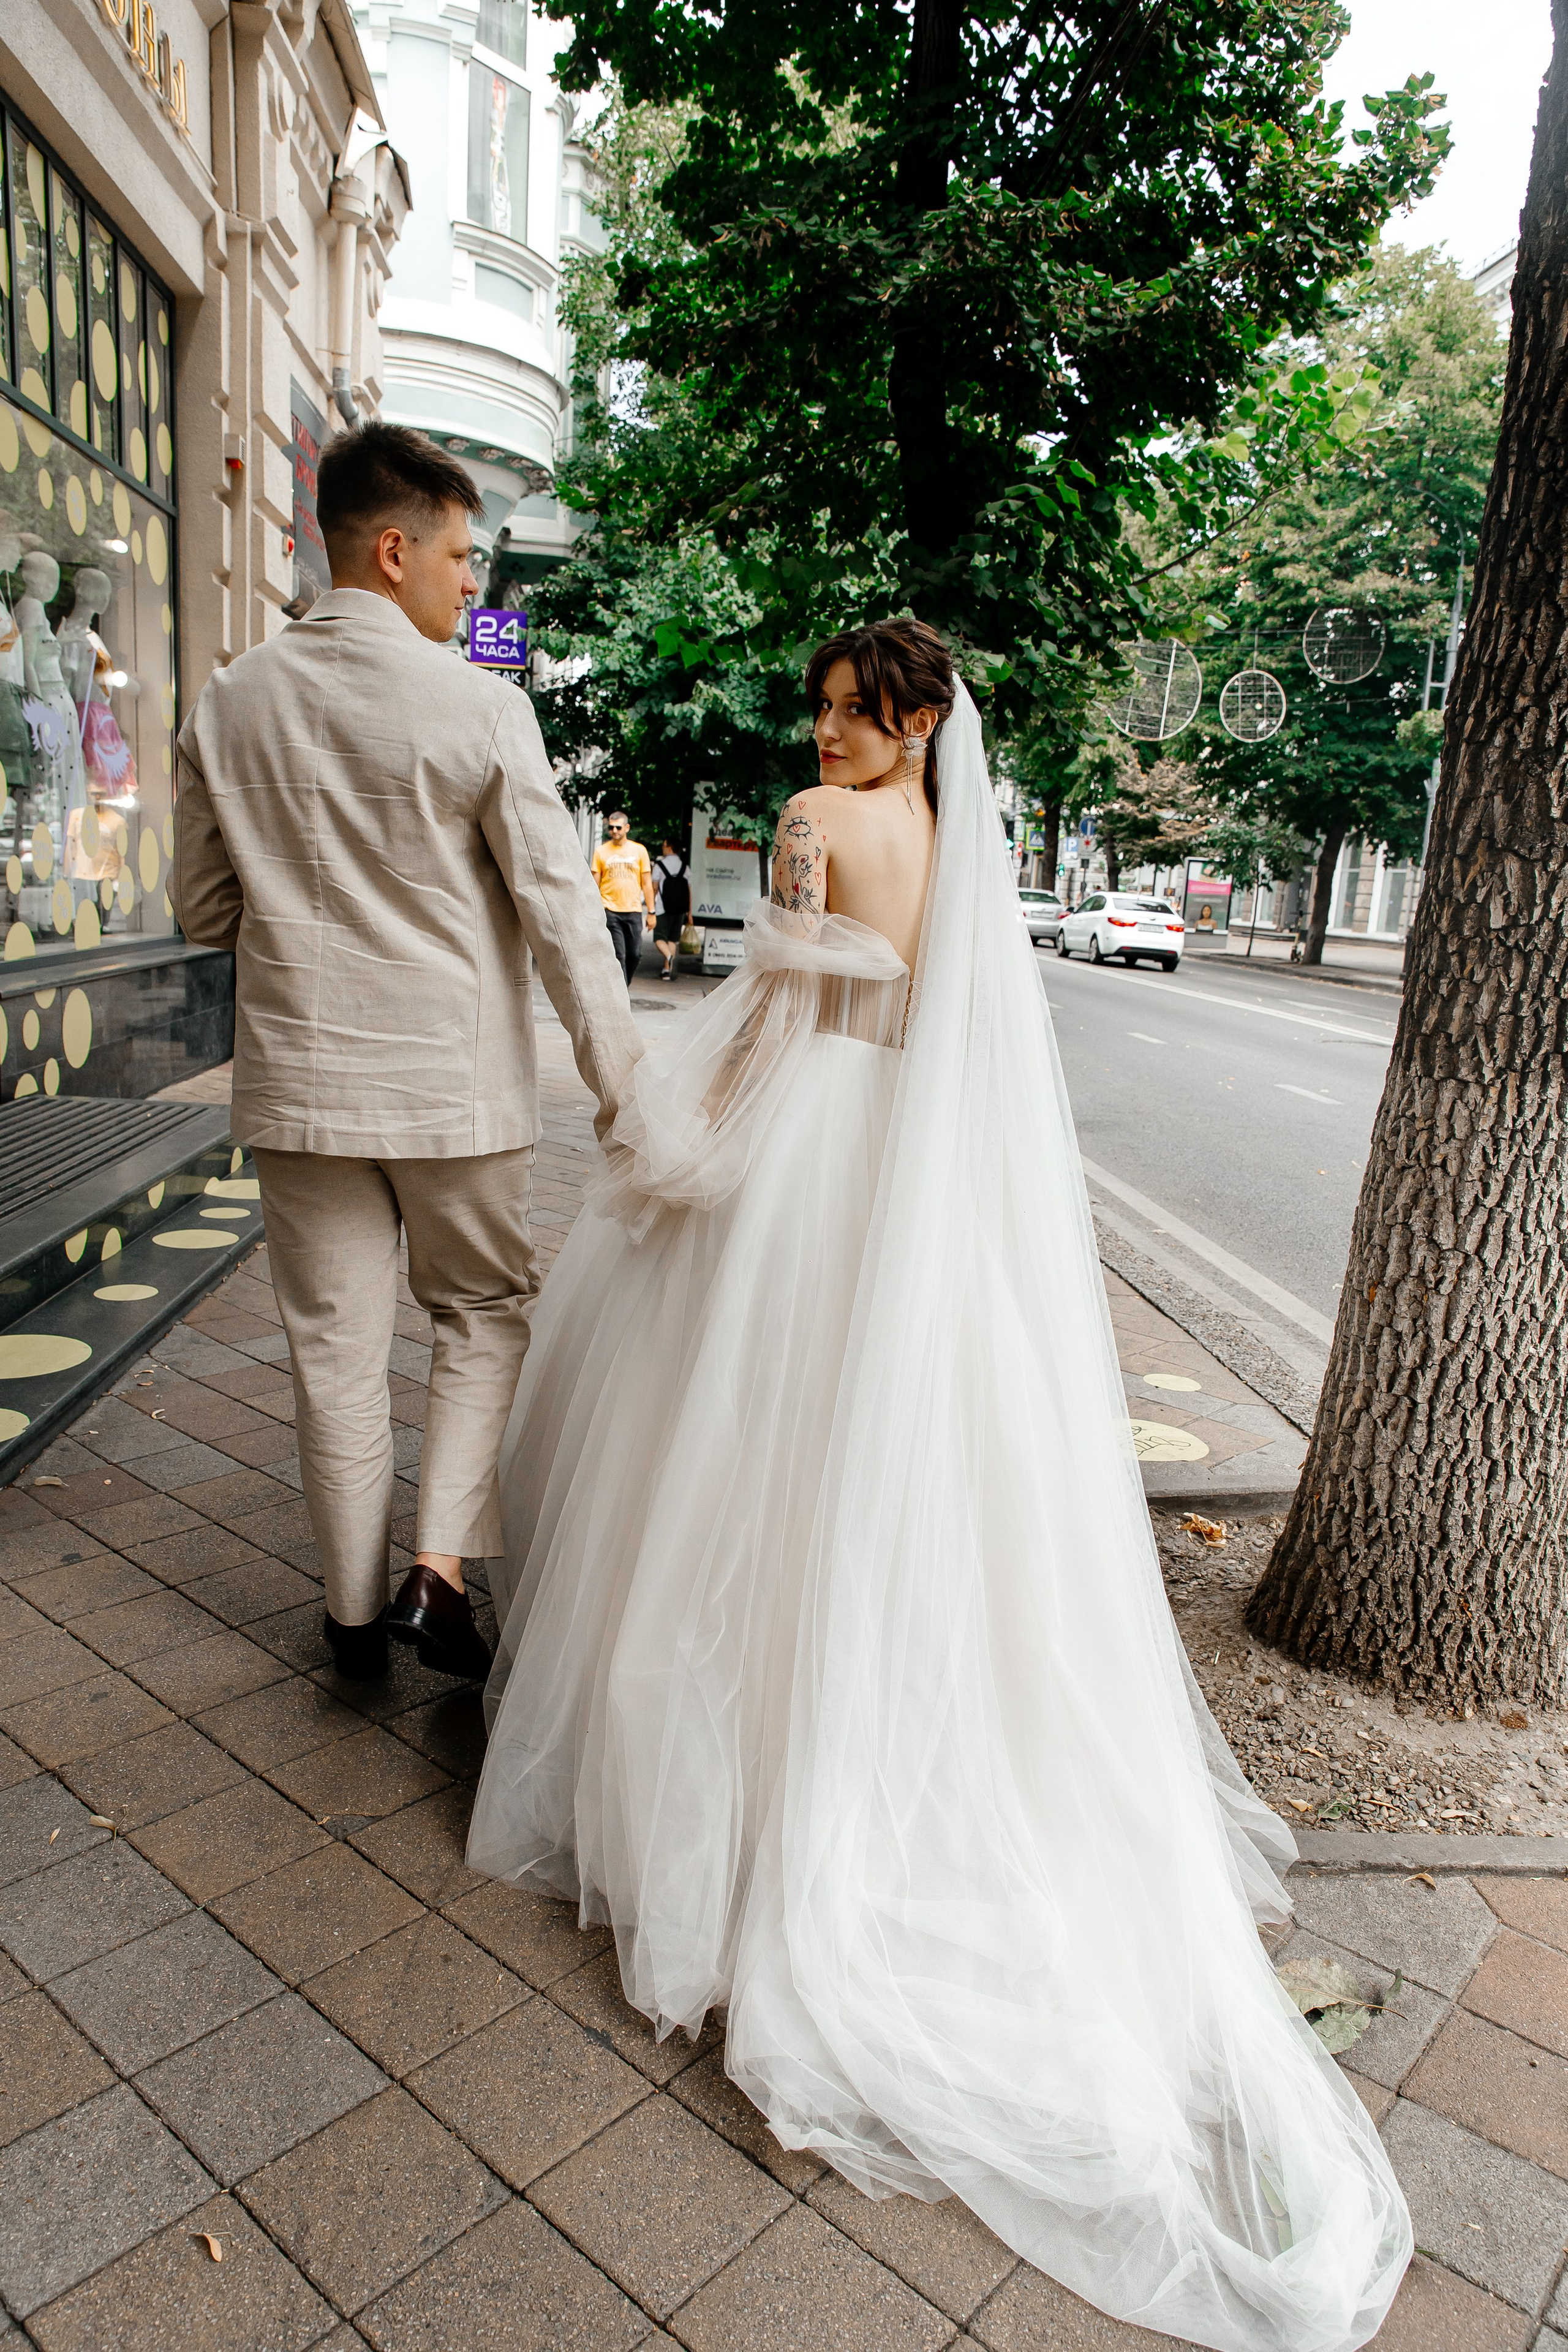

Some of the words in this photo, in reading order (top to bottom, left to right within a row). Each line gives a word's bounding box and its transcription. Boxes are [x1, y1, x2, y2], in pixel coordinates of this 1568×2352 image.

[475, 616, 519, 644] 24
[475, 643, 520, 658] ЧАСА
[698, 904, 722, 914] AVA
